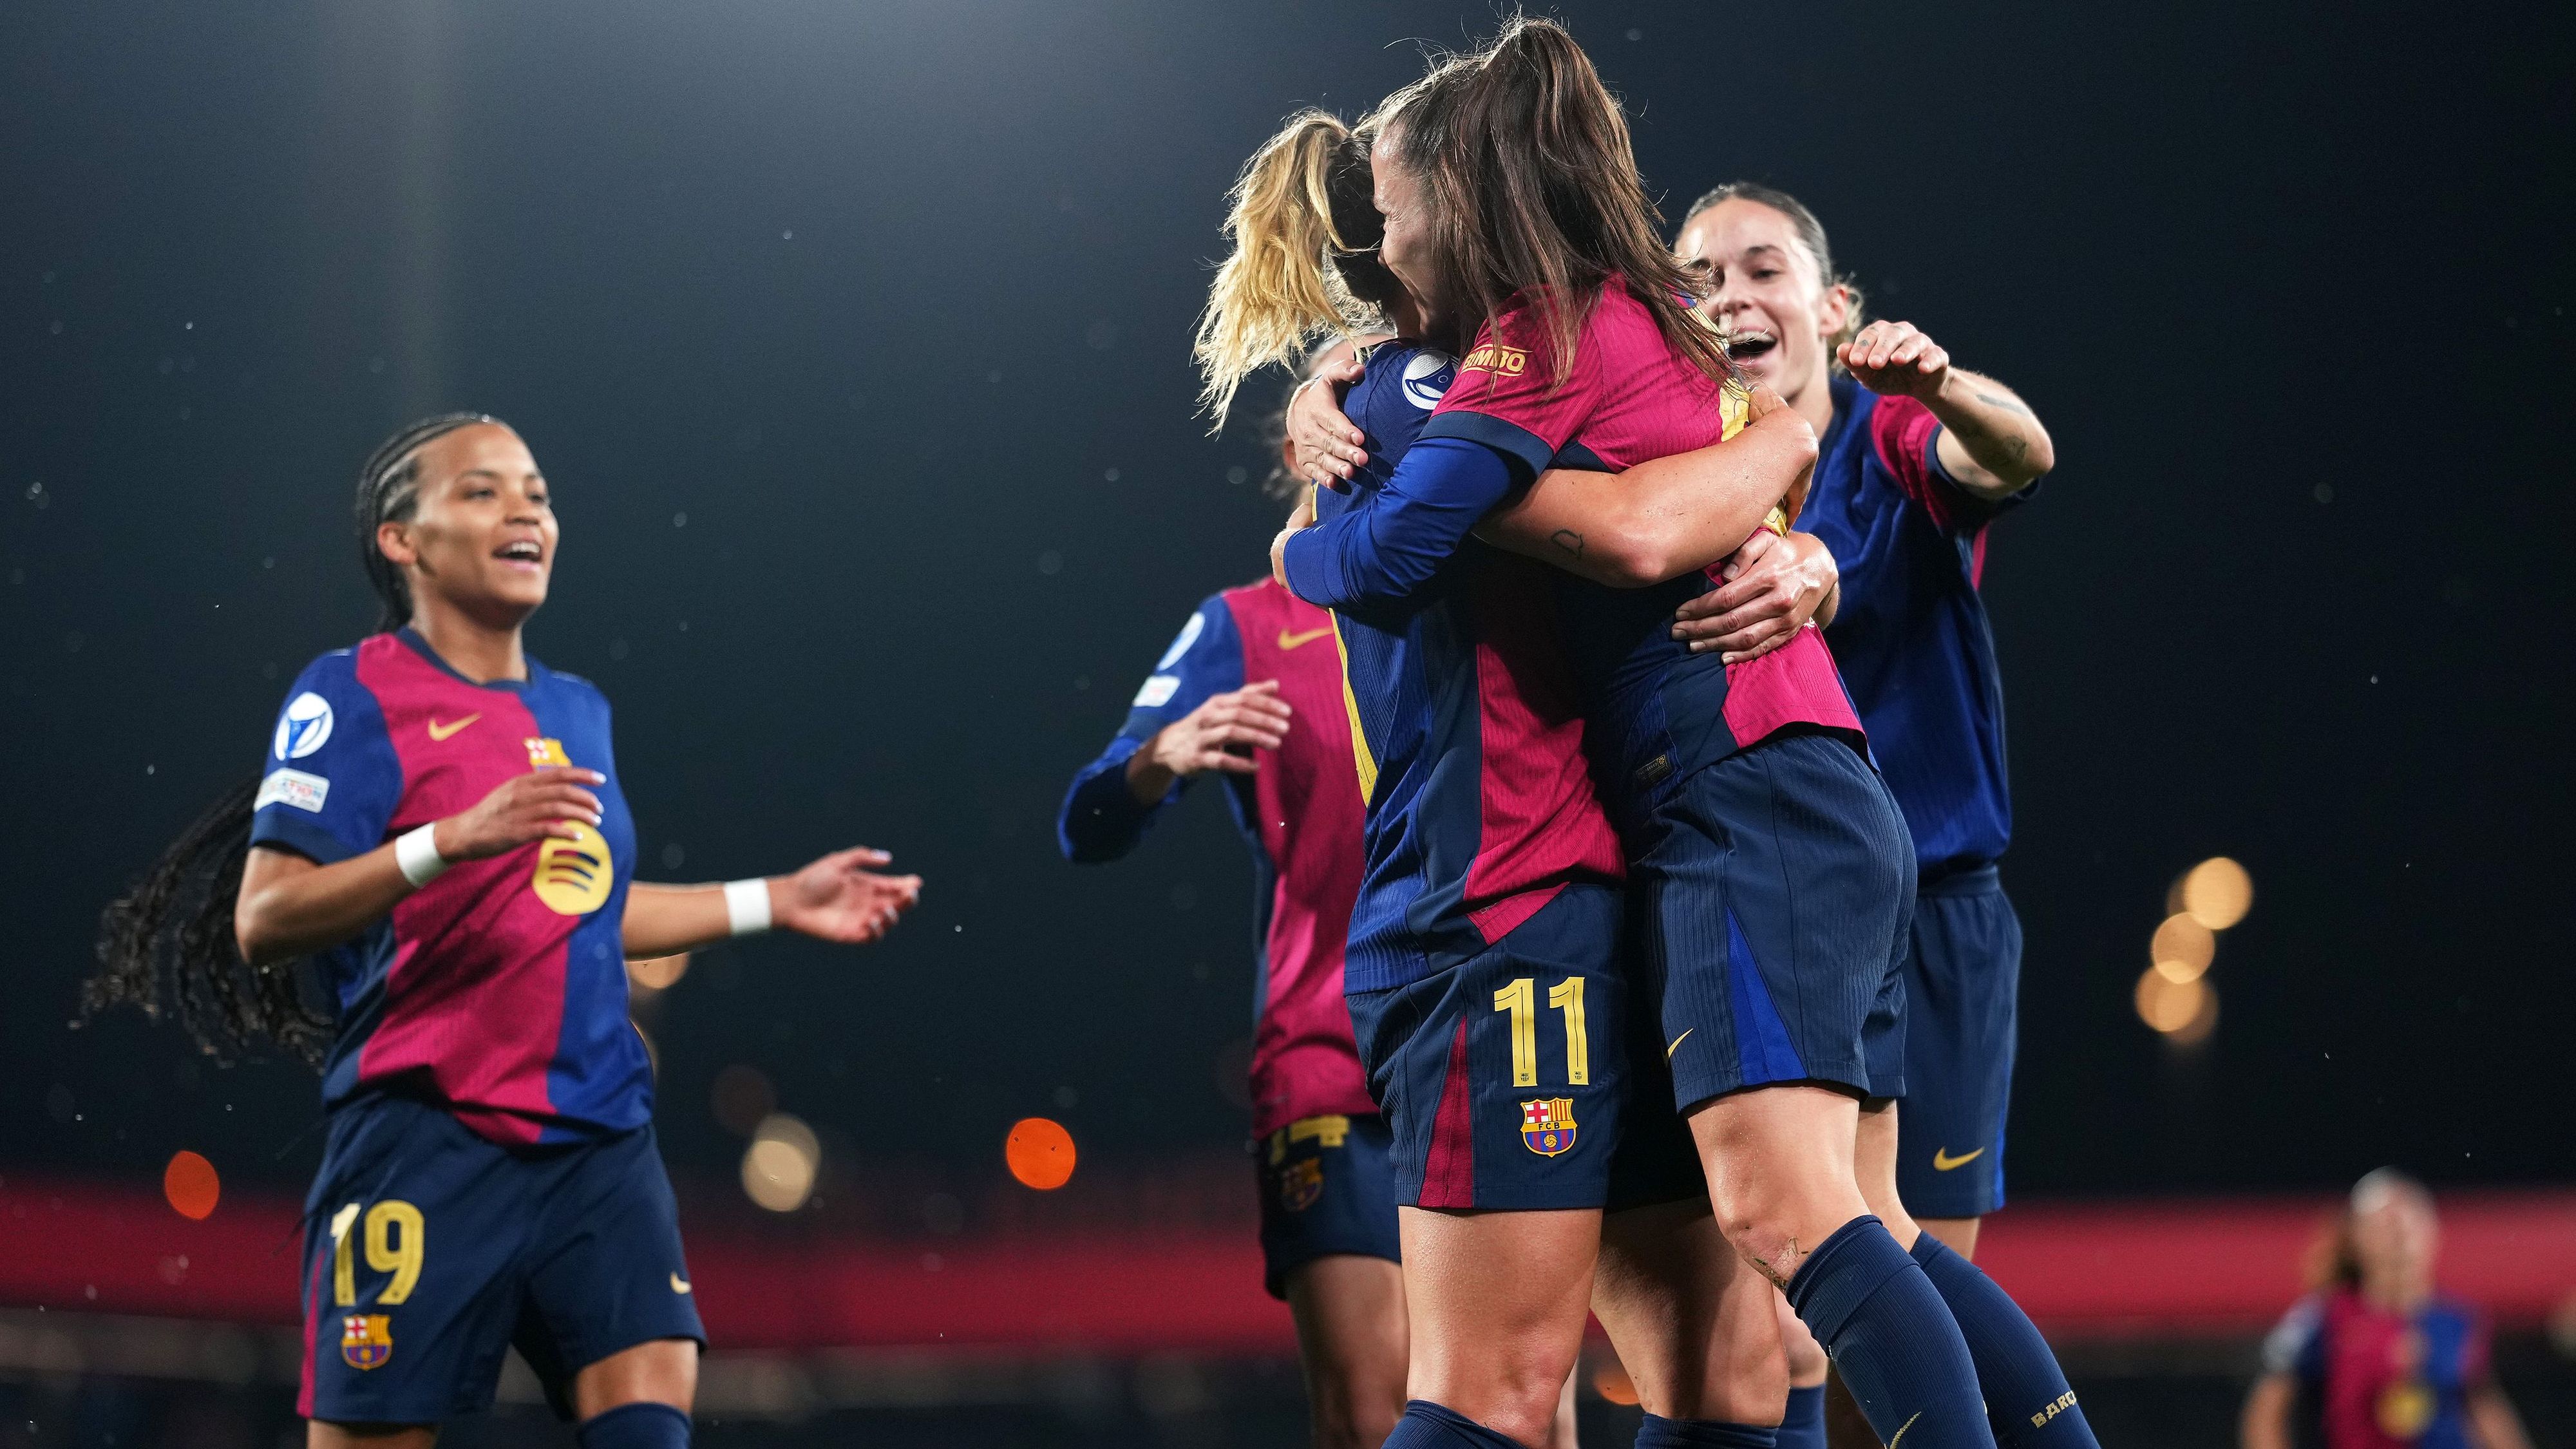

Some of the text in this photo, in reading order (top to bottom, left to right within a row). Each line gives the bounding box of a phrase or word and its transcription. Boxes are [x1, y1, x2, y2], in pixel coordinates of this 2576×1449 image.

[1463, 349, 1526, 372] BIMBO
[1493, 976, 1589, 1087] 11
[329, 1198, 426, 1307] 19
